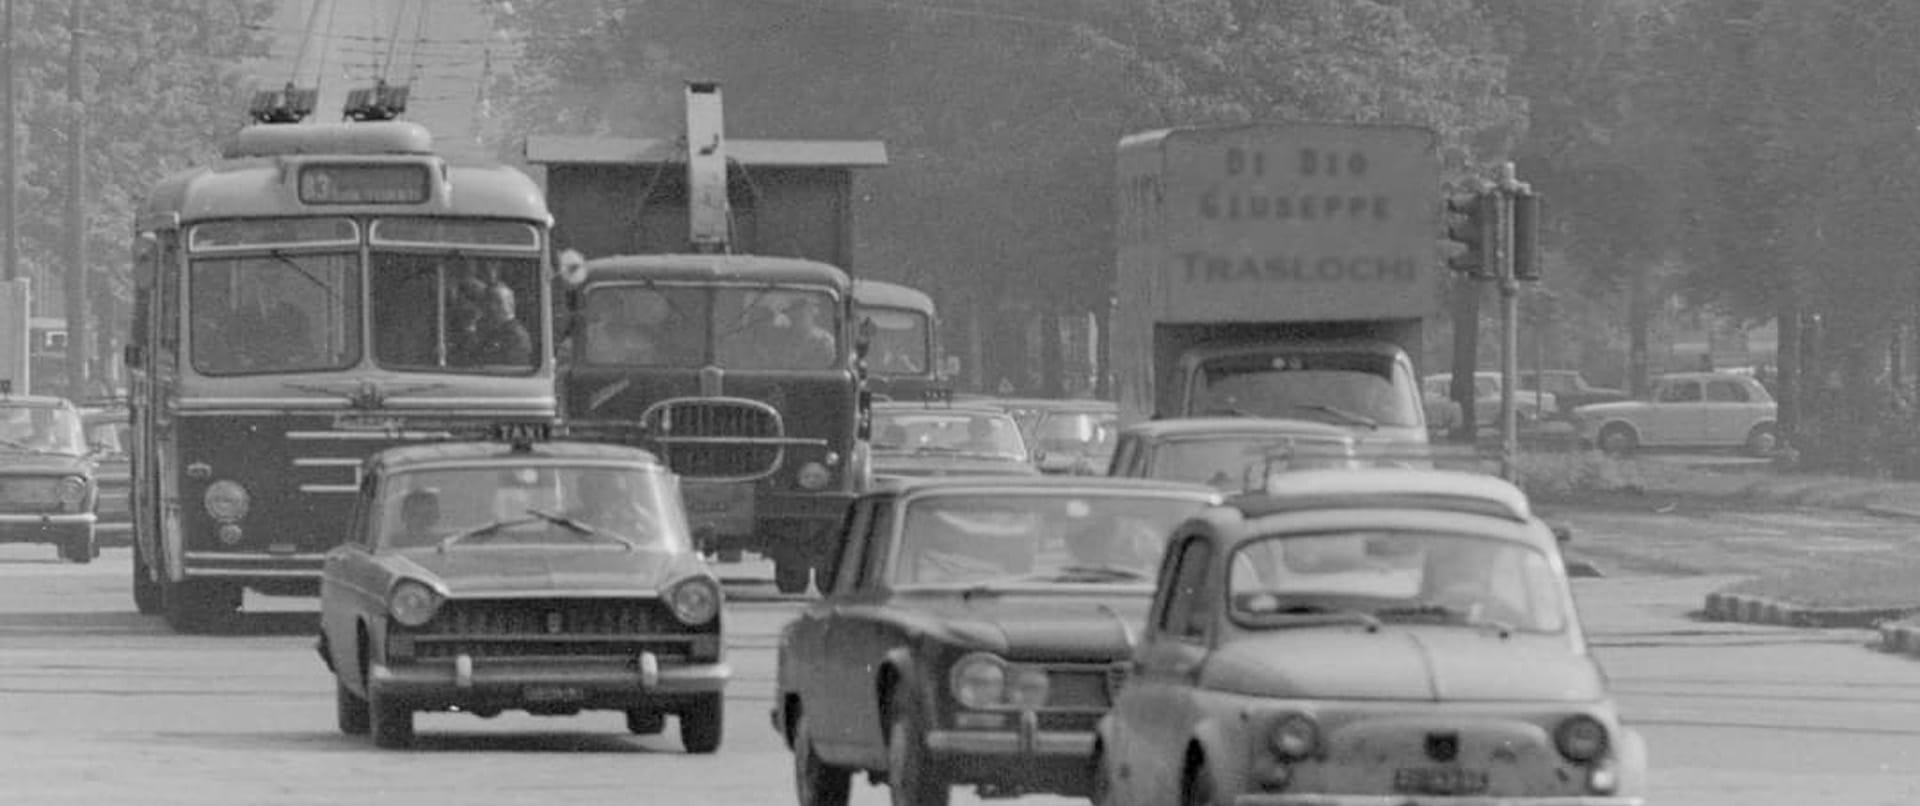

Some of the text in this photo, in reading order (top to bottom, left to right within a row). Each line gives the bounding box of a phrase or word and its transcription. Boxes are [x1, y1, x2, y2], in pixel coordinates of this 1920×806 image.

[1200, 192, 1390, 221] GIUSEPPE
[1180, 253, 1417, 283] TRASLOCHI
[500, 424, 545, 440] TAXI
